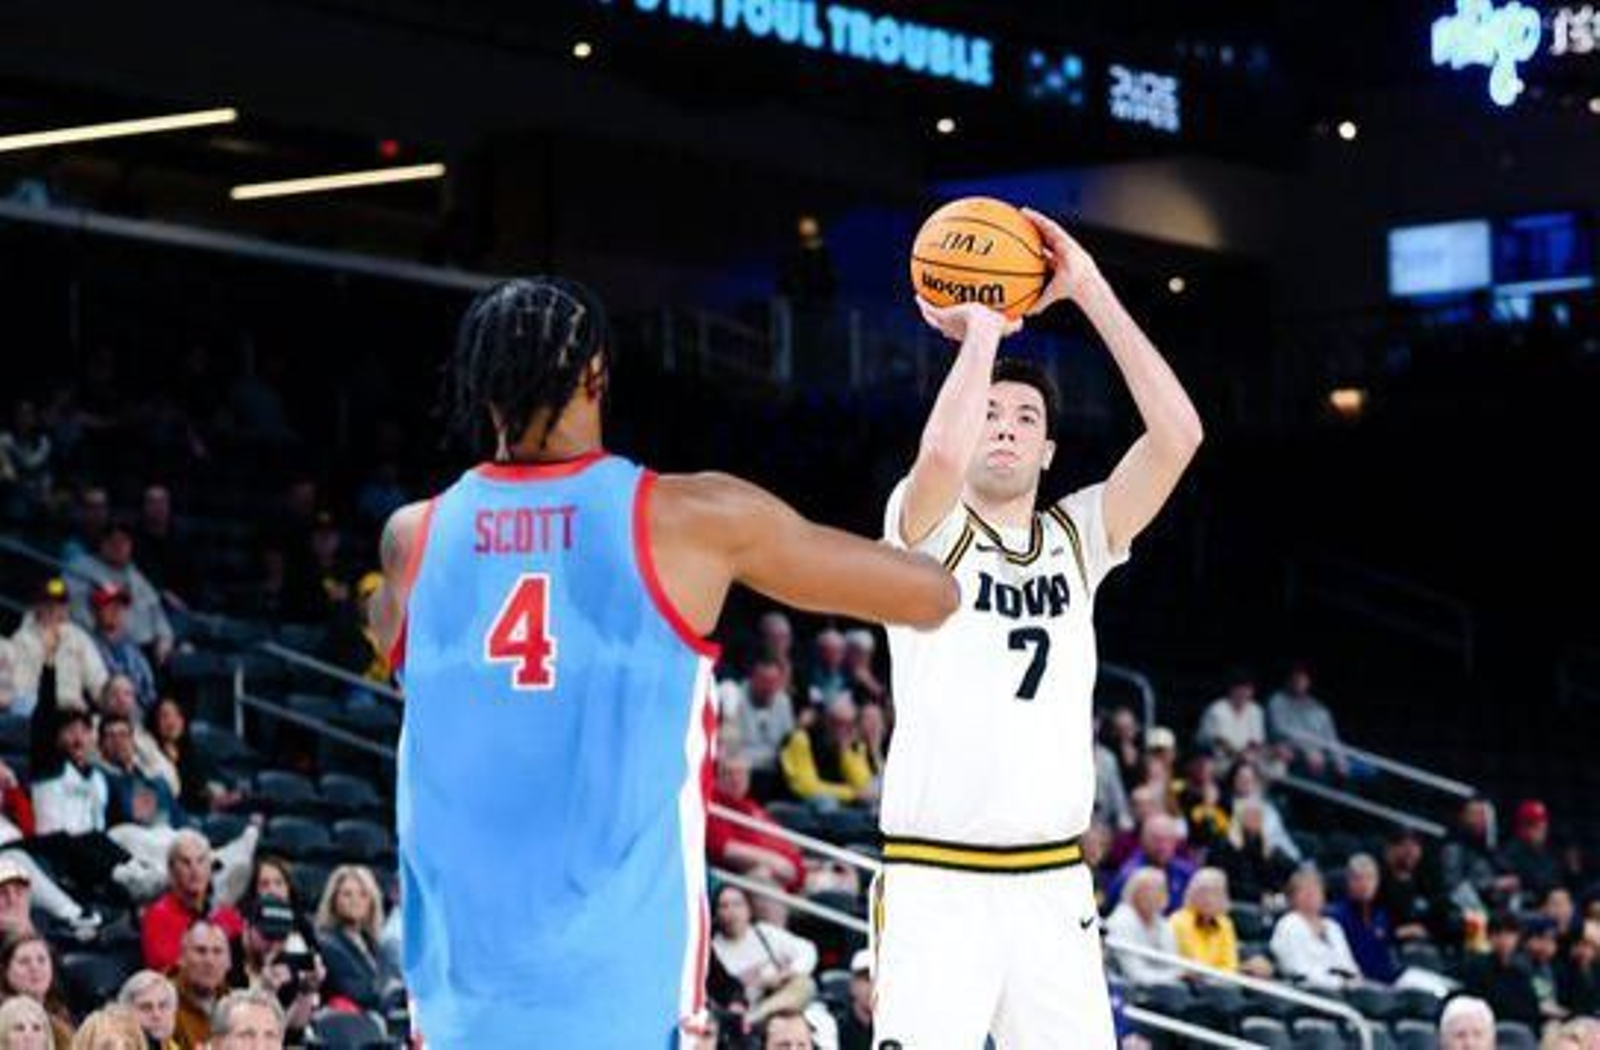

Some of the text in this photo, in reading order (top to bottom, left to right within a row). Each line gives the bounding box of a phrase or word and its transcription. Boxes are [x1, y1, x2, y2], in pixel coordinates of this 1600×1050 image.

[722, 0, 992, 86] FOUL TROUBLE
[475, 506, 577, 554] SCOTT
[484, 572, 557, 690] 4
[974, 571, 1070, 619] IOWA
[1008, 626, 1050, 700] 7
